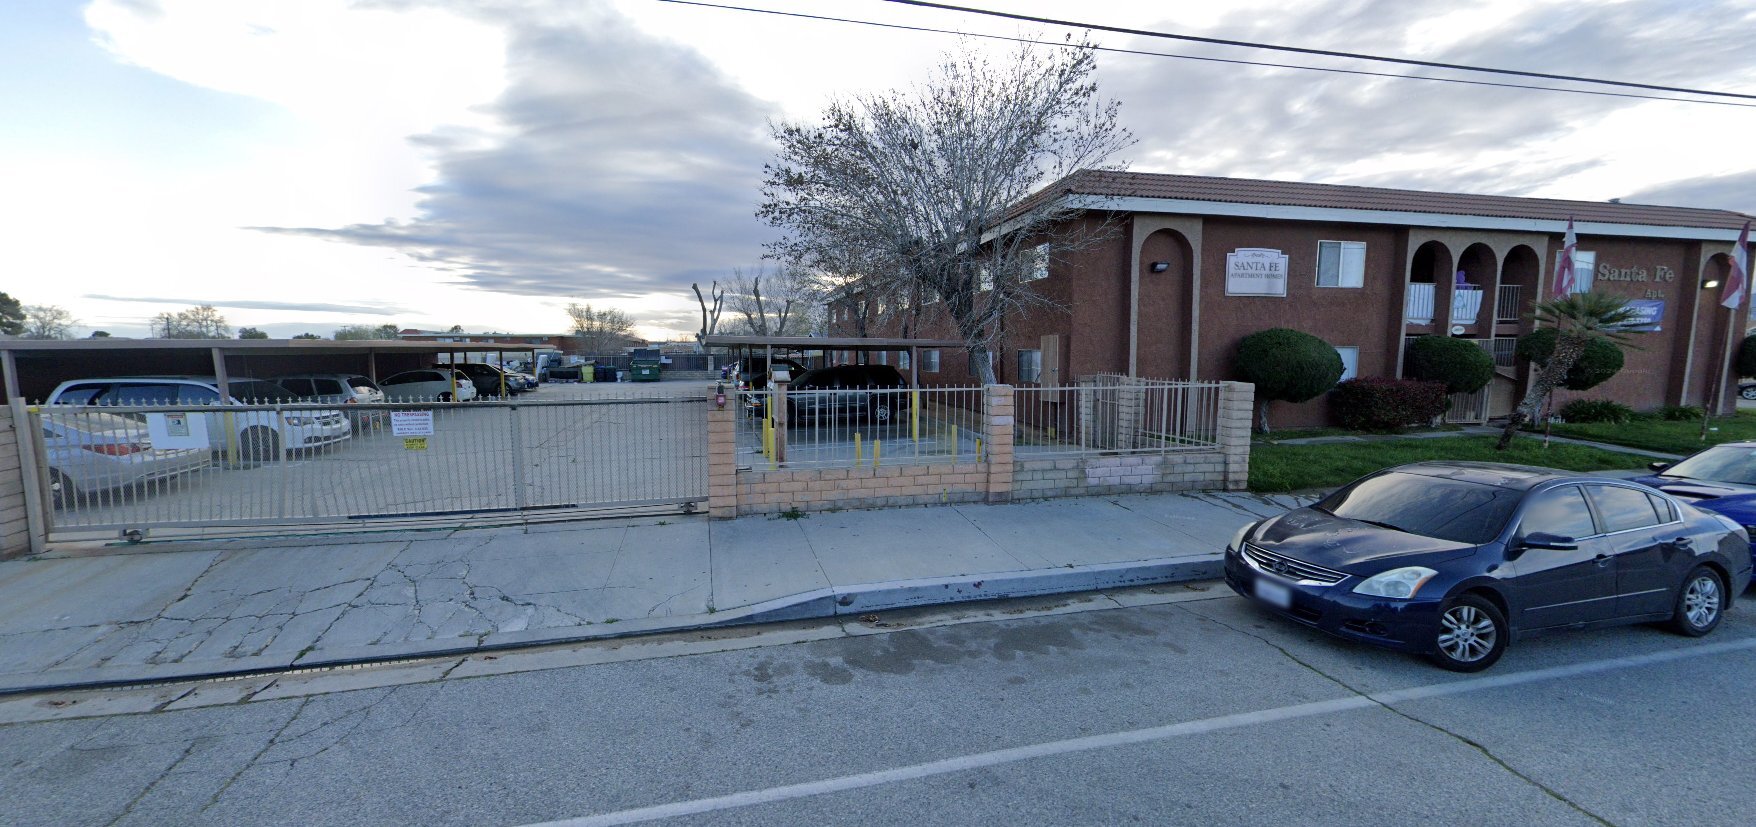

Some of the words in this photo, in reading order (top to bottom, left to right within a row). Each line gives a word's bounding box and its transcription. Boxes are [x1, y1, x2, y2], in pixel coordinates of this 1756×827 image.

[1234, 261, 1266, 271] SANTA
[1269, 262, 1280, 272] FE
[1597, 263, 1647, 282] Santa
[1654, 265, 1674, 282] Fe
